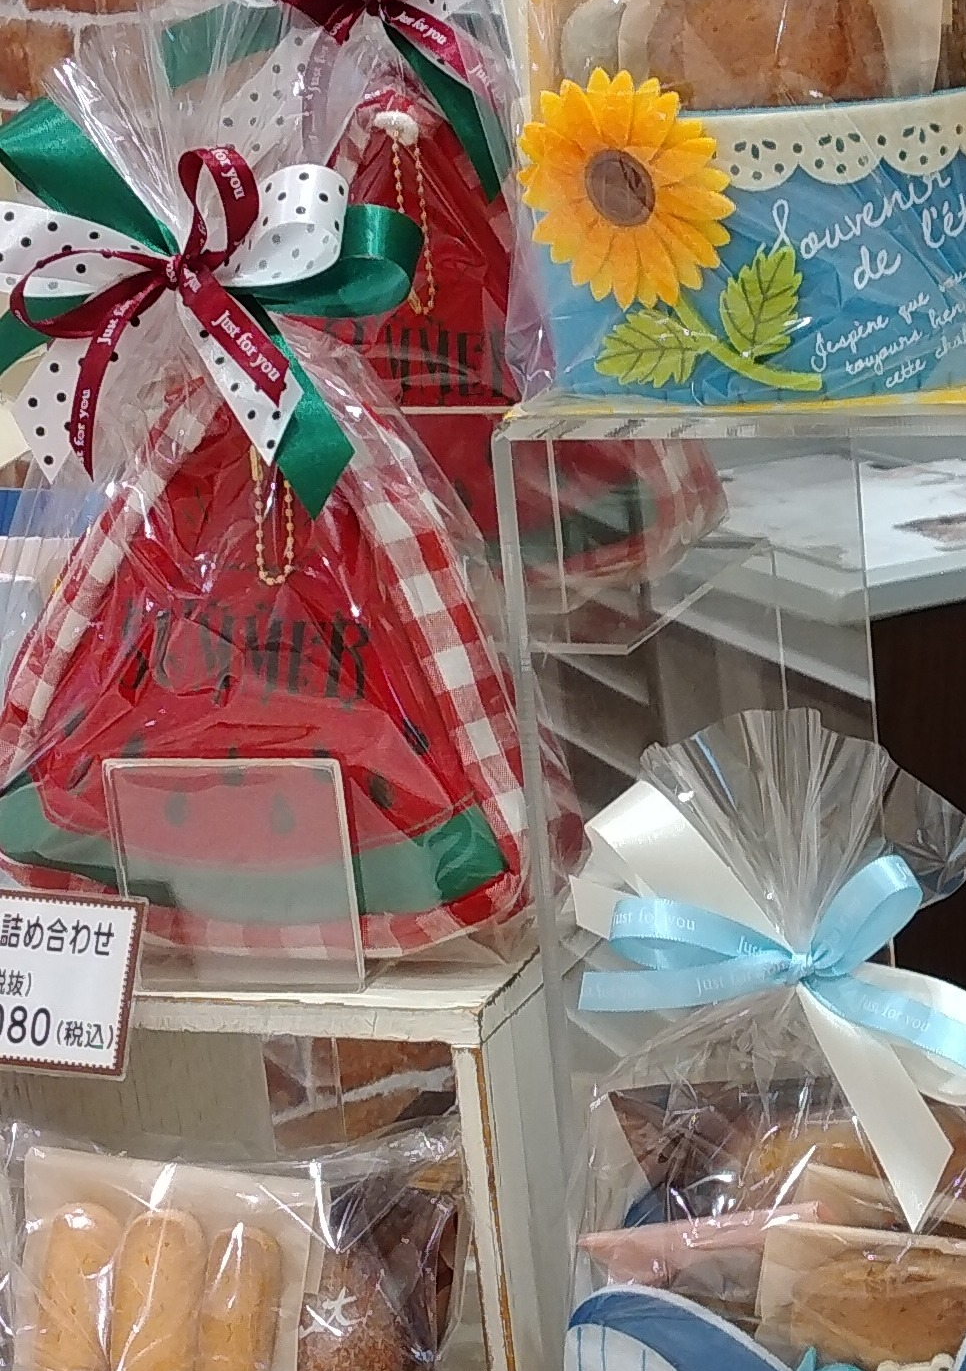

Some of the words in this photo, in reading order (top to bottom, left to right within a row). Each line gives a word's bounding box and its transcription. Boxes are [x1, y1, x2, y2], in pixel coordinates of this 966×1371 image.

[422, 27, 448, 46] you
[221, 164, 246, 201] you
[756, 169, 952, 262] Souvenir
[853, 245, 902, 291] de
[898, 291, 930, 324] que
[211, 309, 242, 336] Just
[235, 330, 258, 357] for
[250, 351, 281, 384] you
[845, 328, 923, 377] toujours
[884, 358, 927, 389] cette
[78, 388, 92, 420] you
[0, 1003, 115, 1050] 80(税込)
